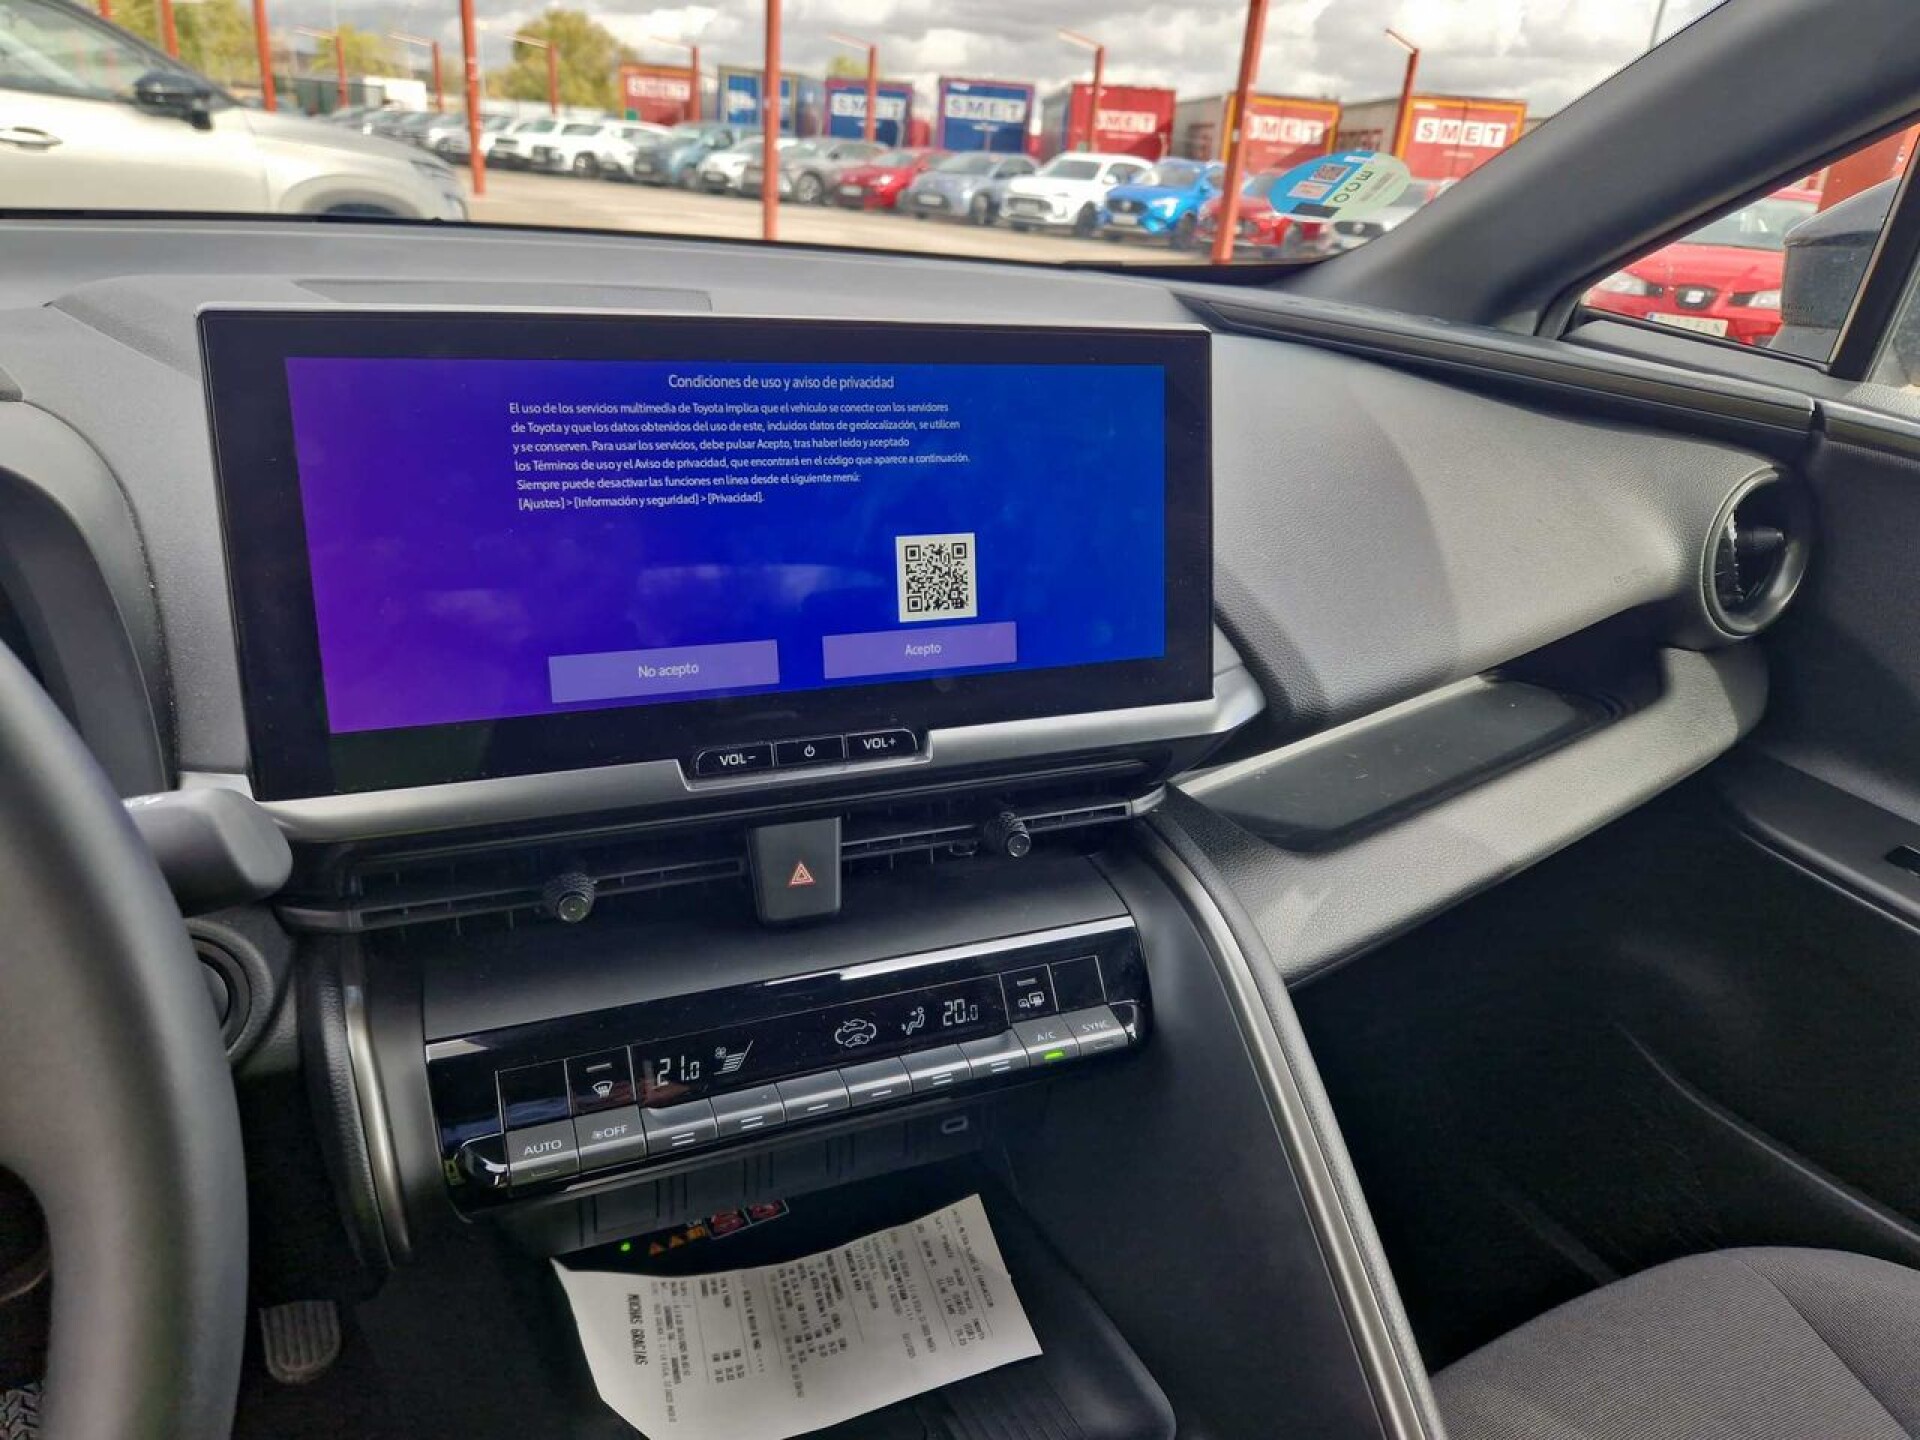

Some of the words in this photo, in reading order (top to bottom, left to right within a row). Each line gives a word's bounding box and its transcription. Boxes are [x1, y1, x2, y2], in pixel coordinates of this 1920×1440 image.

[948, 98, 1022, 121] SMET
[1418, 119, 1505, 147] SMET
[668, 374, 741, 388] Condiciones
[743, 376, 759, 388] de
[761, 378, 781, 388] uso
[784, 379, 790, 391] y
[792, 376, 820, 389] aviso
[822, 376, 837, 388] de
[840, 376, 895, 391] privacidad
[509, 402, 520, 414] El
[522, 405, 541, 414] uso
[542, 403, 557, 414] de
[558, 402, 574, 414] los
[575, 402, 619, 414] servicios
[620, 402, 677, 413] multimedia
[678, 402, 691, 413] de
[693, 402, 723, 415] Toyota
[761, 404, 779, 416] que
[780, 402, 789, 413] el
[791, 402, 827, 413] vehículo
[829, 405, 839, 413] se
[840, 403, 874, 413] conecte
[892, 402, 906, 412] los
[907, 402, 949, 412] servidores
[511, 421, 526, 433] de
[528, 421, 562, 435] Toyota
[564, 425, 570, 435] y
[571, 424, 592, 435] que
[593, 421, 609, 432] los
[610, 421, 640, 432] datos
[641, 420, 691, 432] obtenidos
[693, 420, 708, 431] del
[710, 422, 727, 431] uso
[729, 420, 742, 431] de
[743, 422, 766, 432] este,
[767, 420, 808, 431] incluidos
[809, 420, 836, 431] datos
[837, 420, 848, 430] de
[919, 422, 928, 430] se
[930, 419, 961, 430] utilicen
[513, 443, 520, 454] y
[520, 443, 533, 452] se
[535, 441, 591, 452] conserven.
[592, 440, 614, 451] Para
[615, 442, 637, 451] usar
[638, 439, 654, 450] los
[655, 439, 699, 452] servicios,
[700, 438, 725, 449] debe
[726, 438, 755, 452] pulsar
[757, 438, 793, 451] Acepto,
[793, 437, 811, 448] tras
[812, 437, 838, 448] haber
[839, 436, 861, 447] leído
[863, 439, 869, 450] y
[870, 436, 909, 449] aceptado
[515, 460, 531, 471] los
[533, 460, 579, 471] Términos
[581, 460, 595, 470] de
[597, 461, 614, 470] uso
[615, 461, 622, 472] y
[624, 458, 634, 469] el
[635, 458, 661, 469] Aviso
[662, 457, 676, 468] de
[677, 457, 729, 472] privacidad,
[730, 459, 749, 470] que
[750, 454, 800, 467] encontrará
[801, 457, 812, 466] en
[814, 454, 823, 465] el
[823, 454, 854, 468] código
[856, 456, 874, 467] que
[875, 455, 908, 466] aparece
[517, 479, 560, 492] Siempre
[562, 478, 595, 490] puede
[597, 476, 649, 488] desactivar
[649, 476, 663, 487] las
[665, 475, 711, 487] funciones
[713, 477, 725, 485] en
[751, 473, 780, 485] desde
[781, 472, 789, 483] el
[791, 472, 832, 486] siguiente
[519, 498, 565, 510] [Ajustes]
[574, 496, 638, 509] [Información
[639, 500, 645, 509] y
[646, 494, 700, 508] seguridad]
[904, 641, 941, 657] Acepto
[638, 664, 657, 678] No
[658, 663, 699, 677] acepto
[863, 738, 897, 751] VOL+
[942, 998, 979, 1027] 20.0
[1082, 1021, 1108, 1033] SYNC
[1037, 1031, 1057, 1042] A/C
[656, 1055, 700, 1087] 21.0
[604, 1124, 628, 1138] OFF
[524, 1139, 563, 1156] AUTO
[627, 1293, 643, 1325] MUCHAS
[631, 1328, 648, 1365] GRACIAS
